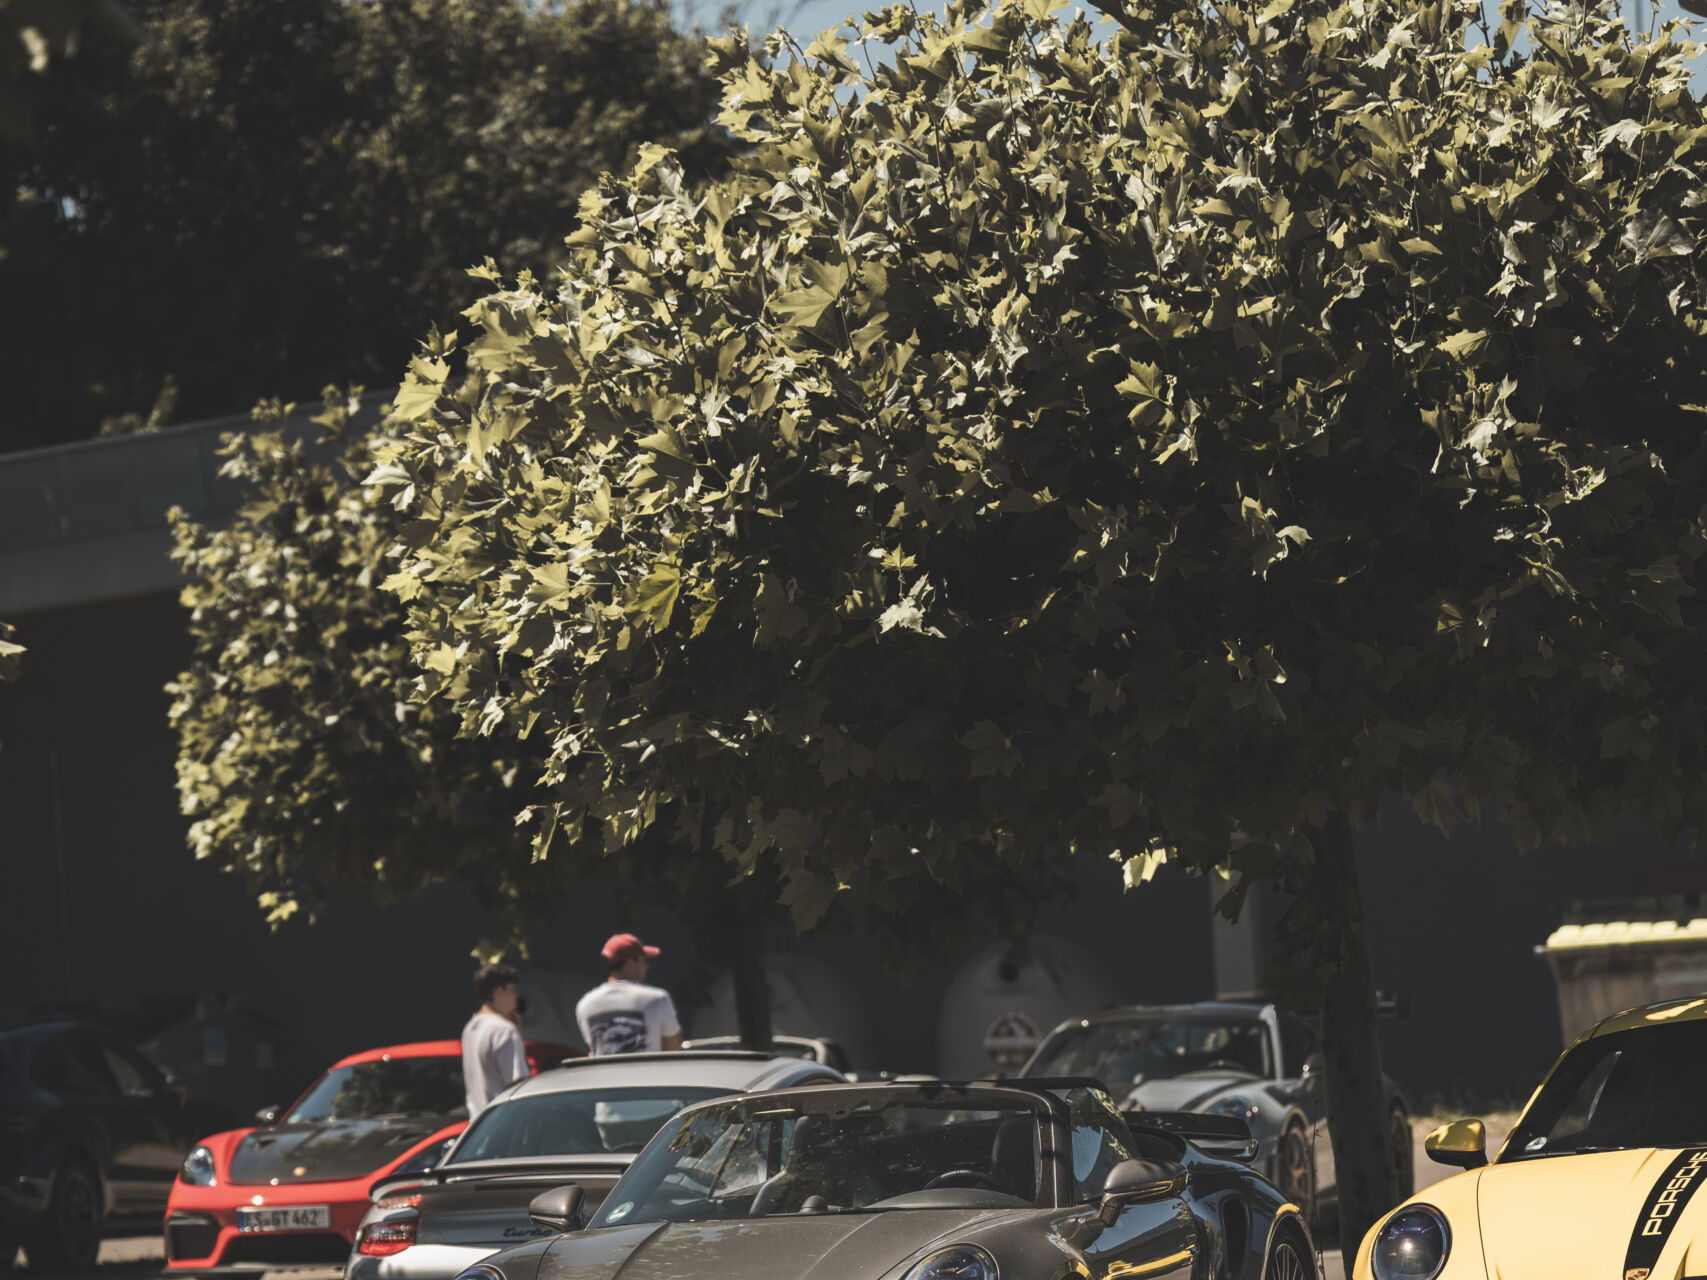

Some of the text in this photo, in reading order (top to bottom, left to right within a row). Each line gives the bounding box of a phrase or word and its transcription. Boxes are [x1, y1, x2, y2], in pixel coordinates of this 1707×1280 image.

[271, 1209, 288, 1227] GT
[292, 1208, 318, 1226] 462
[503, 1226, 553, 1237] turbo
